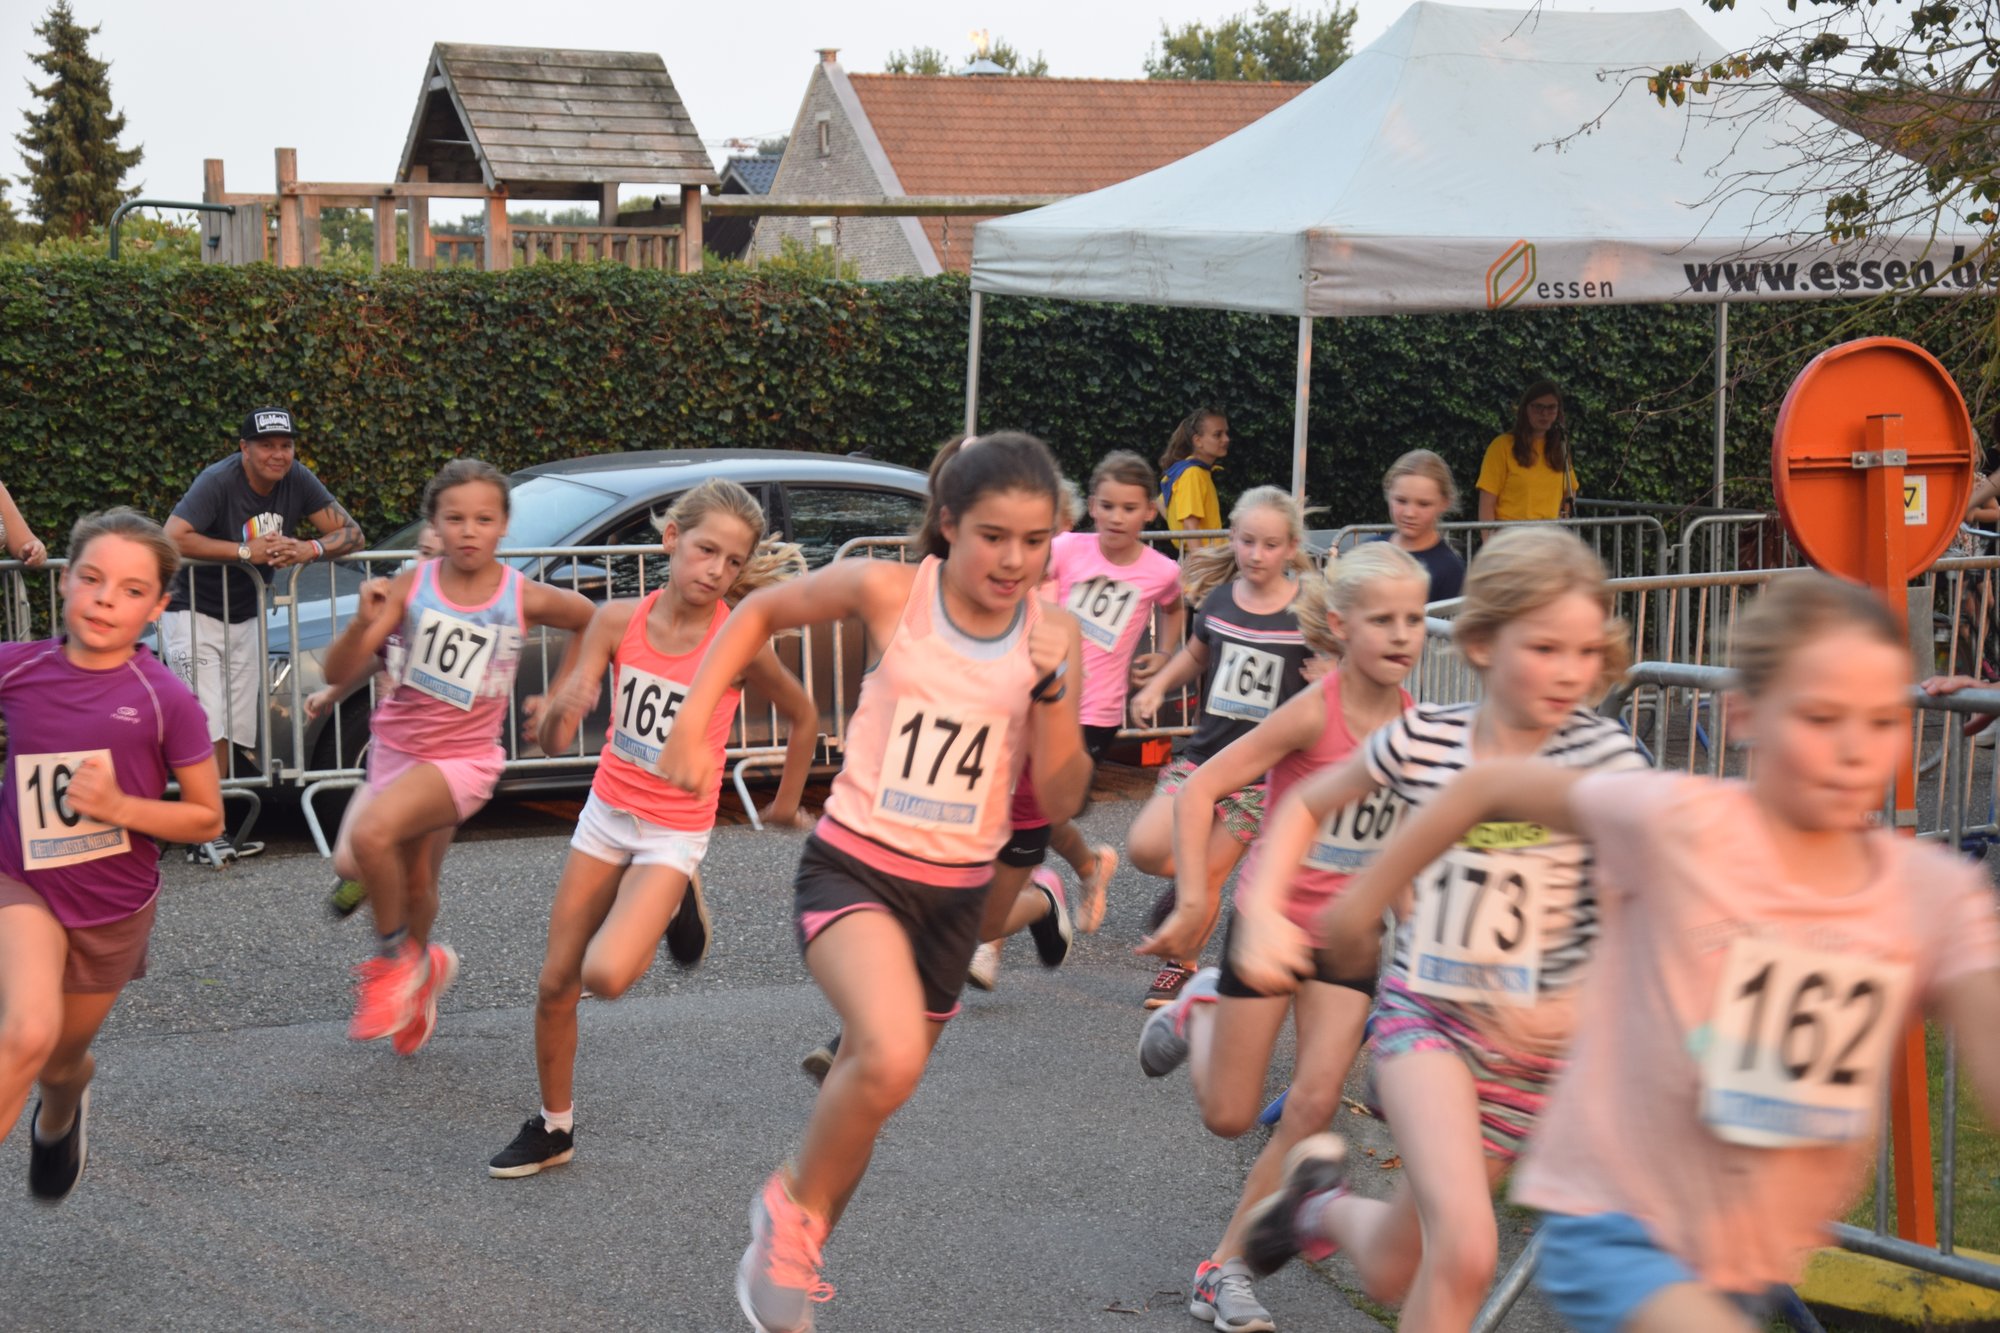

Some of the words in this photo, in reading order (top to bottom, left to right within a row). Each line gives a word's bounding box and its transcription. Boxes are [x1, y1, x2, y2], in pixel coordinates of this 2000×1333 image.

[1537, 281, 1613, 299] essen
[1076, 575, 1134, 626] 161
[425, 620, 488, 679] 167
[1223, 651, 1275, 701] 164
[622, 676, 685, 744] 165
[900, 711, 990, 791] 174
[28, 764, 84, 828] 16
[1434, 862, 1528, 951] 173
[1736, 960, 1885, 1085] 162
